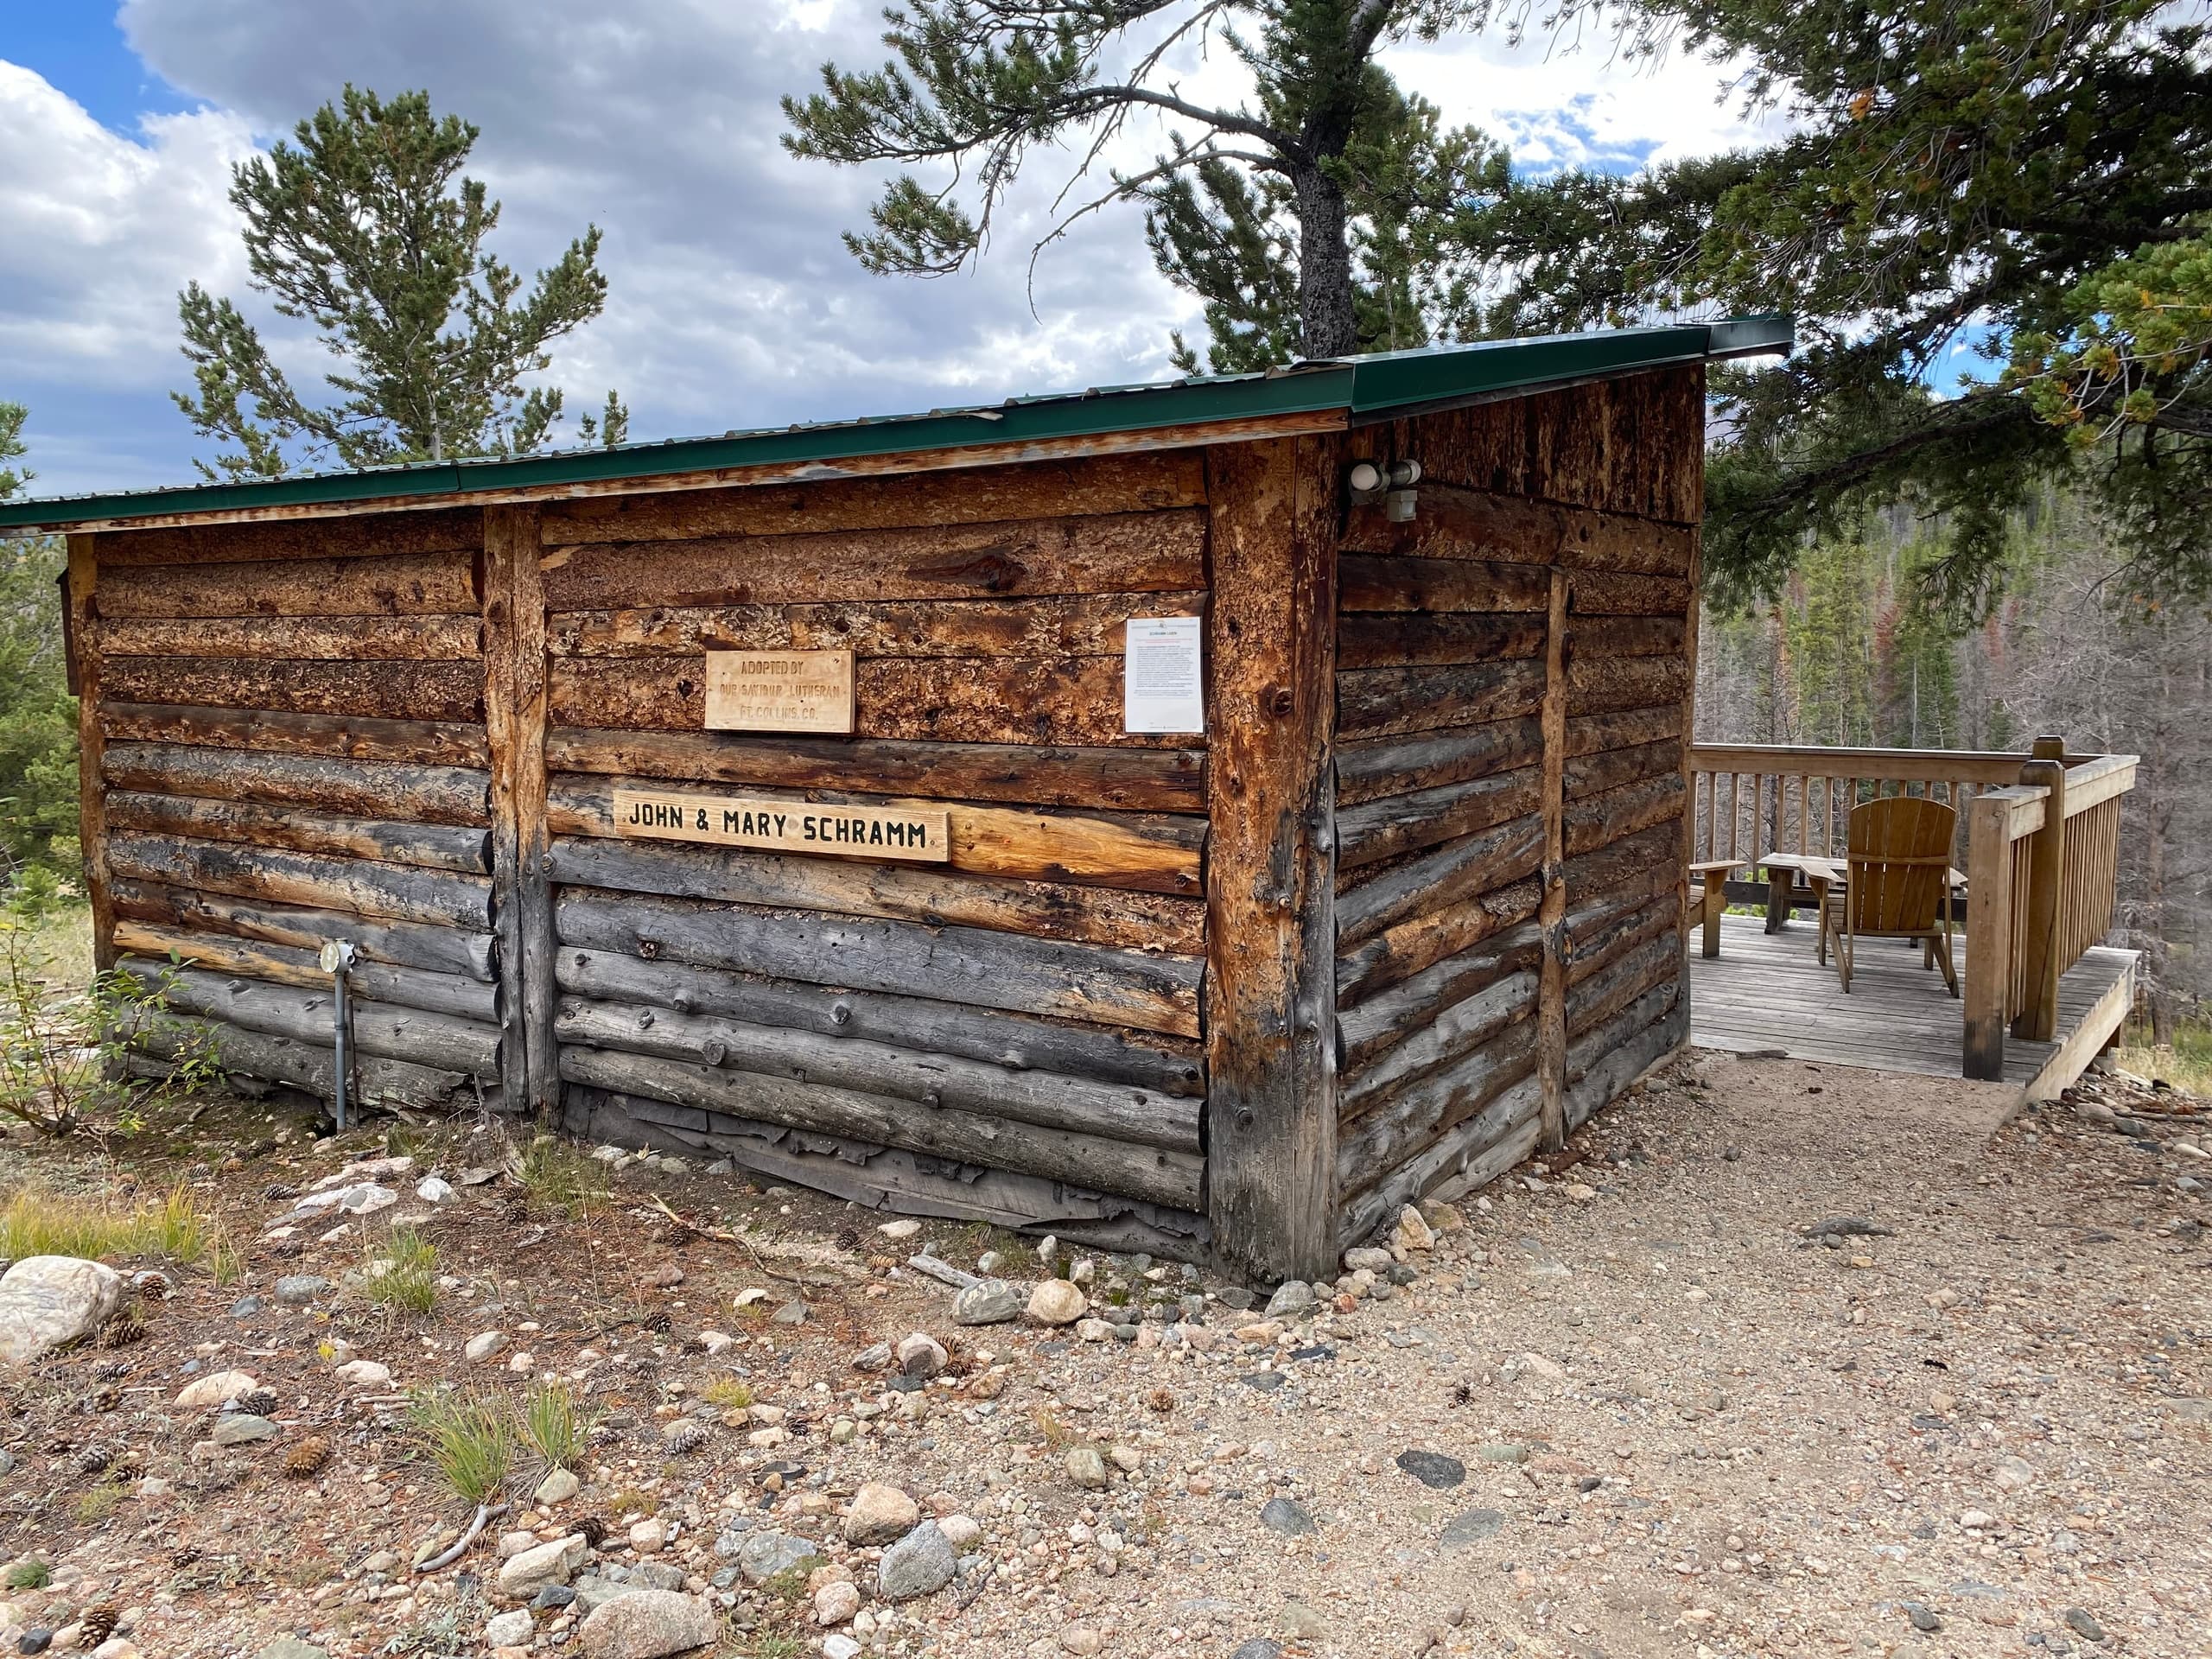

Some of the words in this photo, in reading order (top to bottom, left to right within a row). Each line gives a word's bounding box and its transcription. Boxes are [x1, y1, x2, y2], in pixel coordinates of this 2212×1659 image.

[741, 661, 787, 675] ADOPTED
[791, 662, 804, 675] BY
[720, 683, 737, 697] OUR
[789, 685, 840, 699] LUTHERAN
[629, 803, 683, 829] JOHN
[696, 808, 709, 831] &
[723, 810, 787, 837] MARY
[804, 816, 925, 849] SCHRAMM
